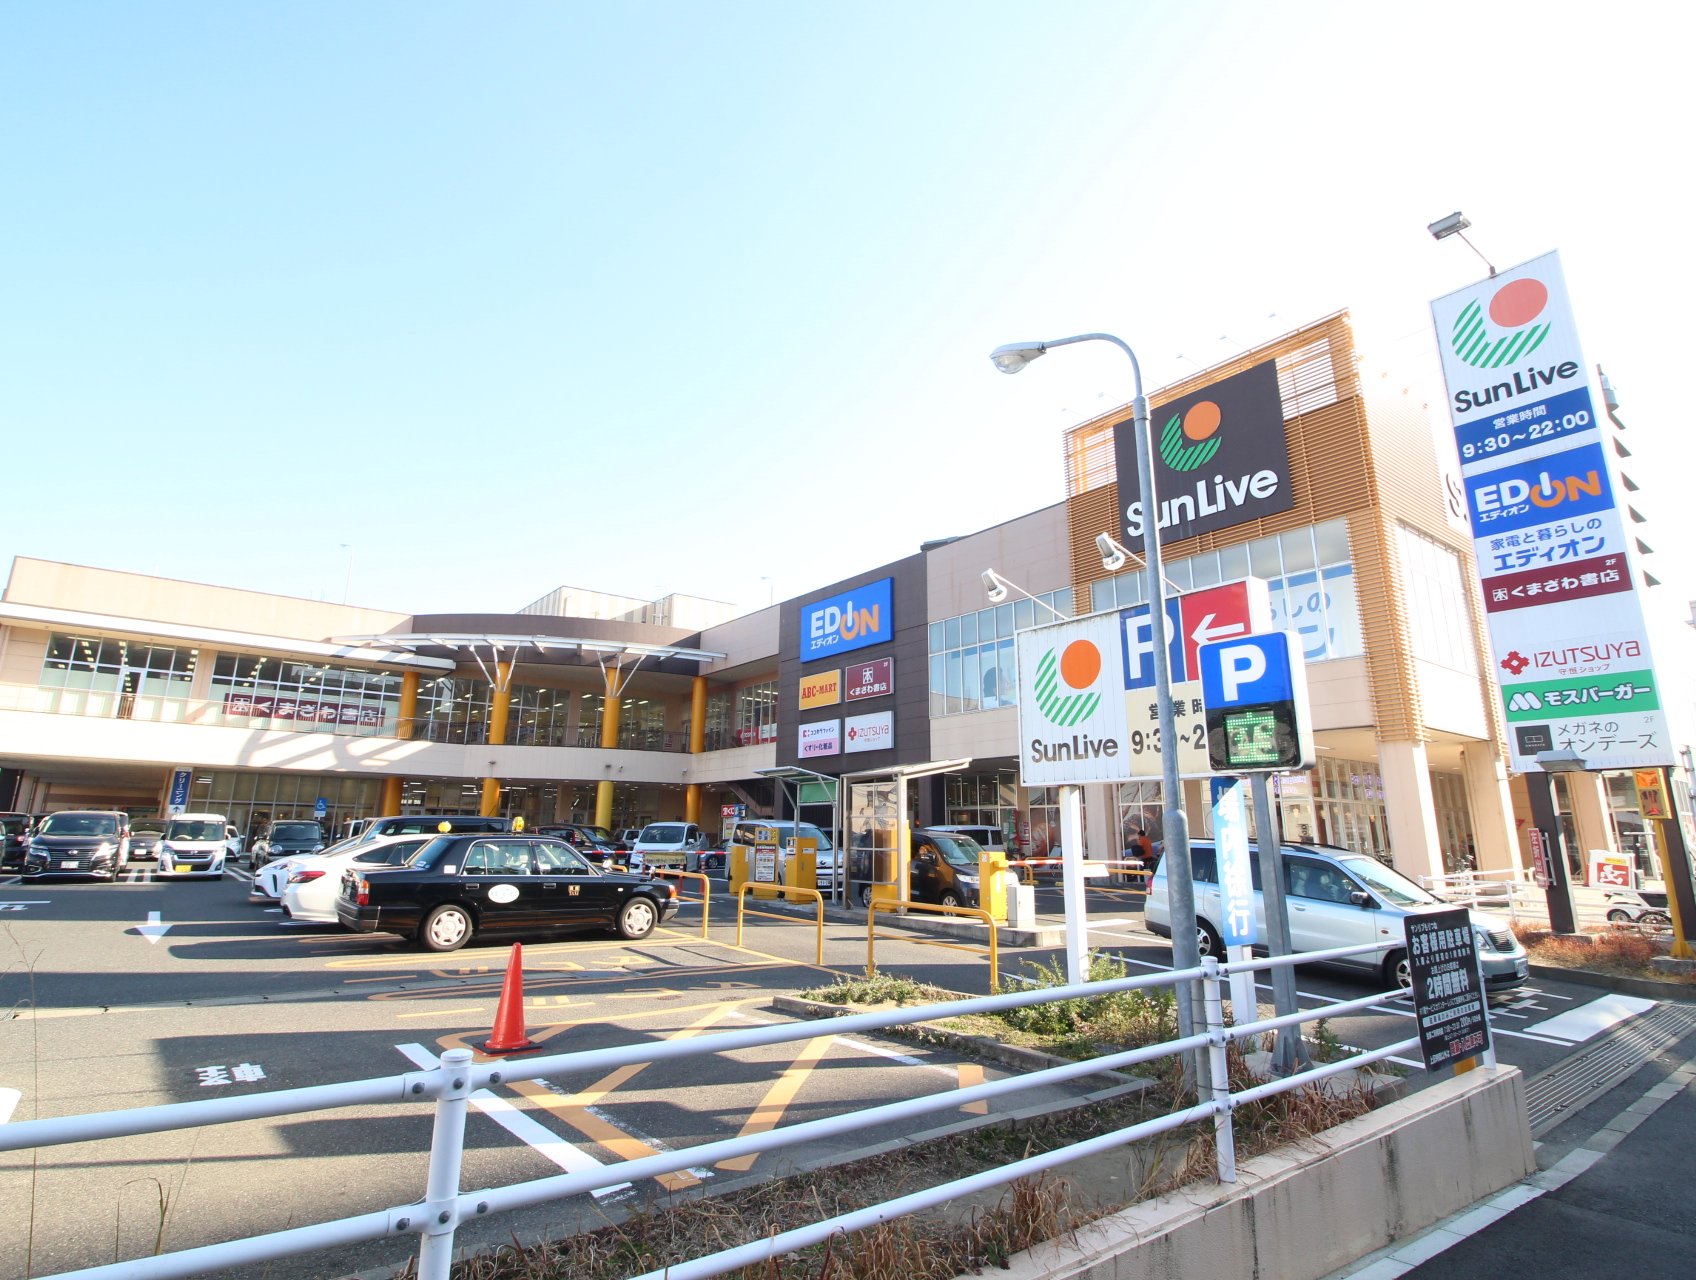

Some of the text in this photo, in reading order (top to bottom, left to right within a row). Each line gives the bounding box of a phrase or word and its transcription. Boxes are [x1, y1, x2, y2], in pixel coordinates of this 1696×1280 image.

[1454, 361, 1578, 412] SunLive
[1492, 404, 1547, 429] 営業時間
[1127, 469, 1279, 537] SunLive
[1474, 470, 1601, 512] EDION
[1480, 504, 1530, 522] エディオン
[1491, 518, 1602, 551] 家電と暮らしの
[1494, 535, 1605, 572] エディオン
[1605, 558, 1616, 566] 2F
[1511, 569, 1620, 598] くまざわ書店
[811, 600, 879, 640] EDION
[811, 634, 838, 650] エディオン
[1219, 645, 1266, 702] P
[802, 683, 837, 699] ABC-MART
[850, 682, 887, 696] くまざわ書店
[1543, 682, 1652, 707] モスバーガー
[255, 701, 378, 723] くまざわ書店
[1557, 721, 1619, 737] メガネの
[1559, 732, 1658, 753] オンデーズ
[1031, 734, 1118, 764] SunLive
[174, 771, 188, 805] クリーニング
[1411, 926, 1471, 955] お客様用駐車場
[1427, 968, 1470, 999] 2時間無料
